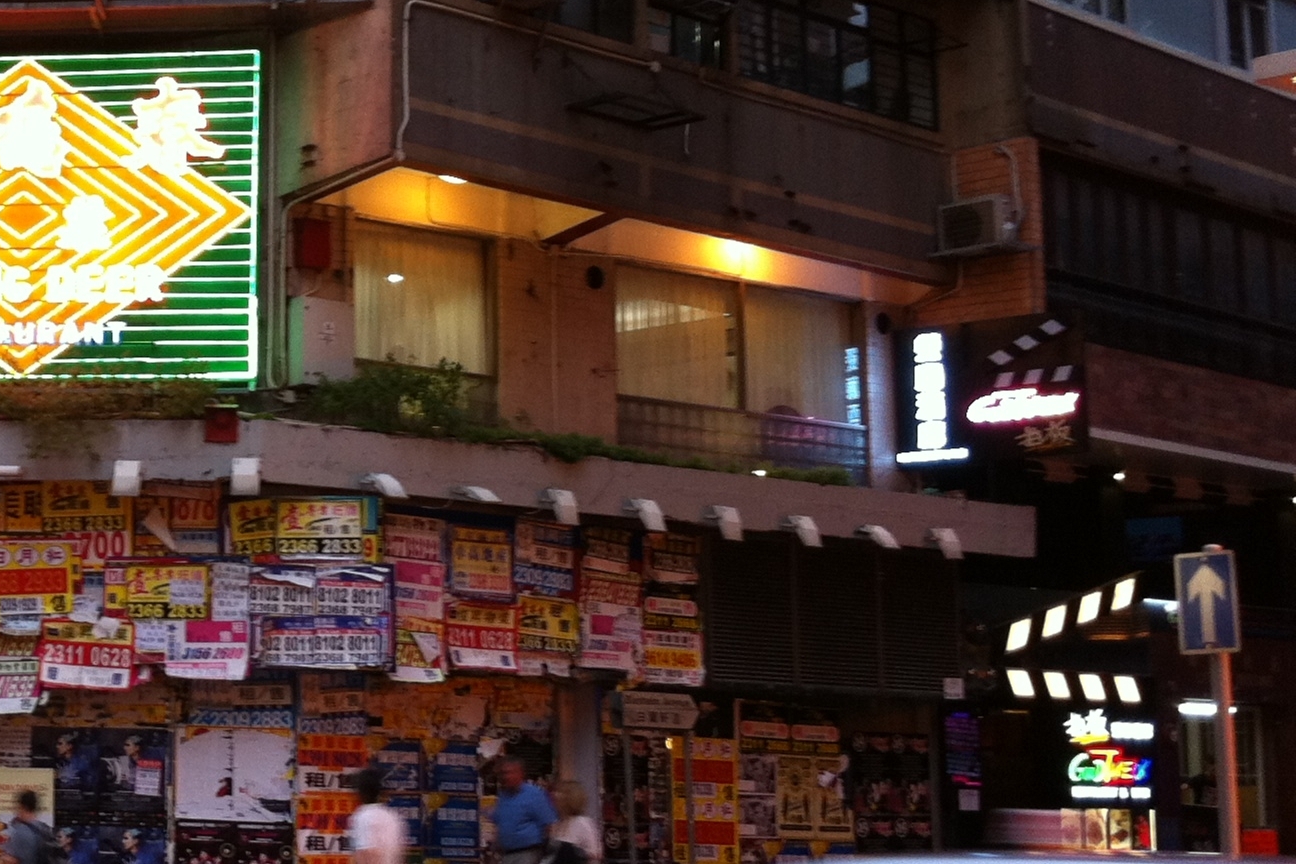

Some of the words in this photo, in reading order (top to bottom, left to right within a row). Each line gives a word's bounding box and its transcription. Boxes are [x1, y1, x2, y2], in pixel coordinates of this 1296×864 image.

[44, 263, 168, 303] DEER
[279, 539, 319, 554] 2366
[321, 539, 362, 554] 2833
[317, 587, 348, 603] 8102
[351, 588, 381, 604] 8011
[128, 603, 165, 618] 2366
[167, 604, 207, 618] 2833
[347, 635, 377, 651] 8011
[44, 643, 85, 665] 2311
[90, 645, 131, 668] 0628
